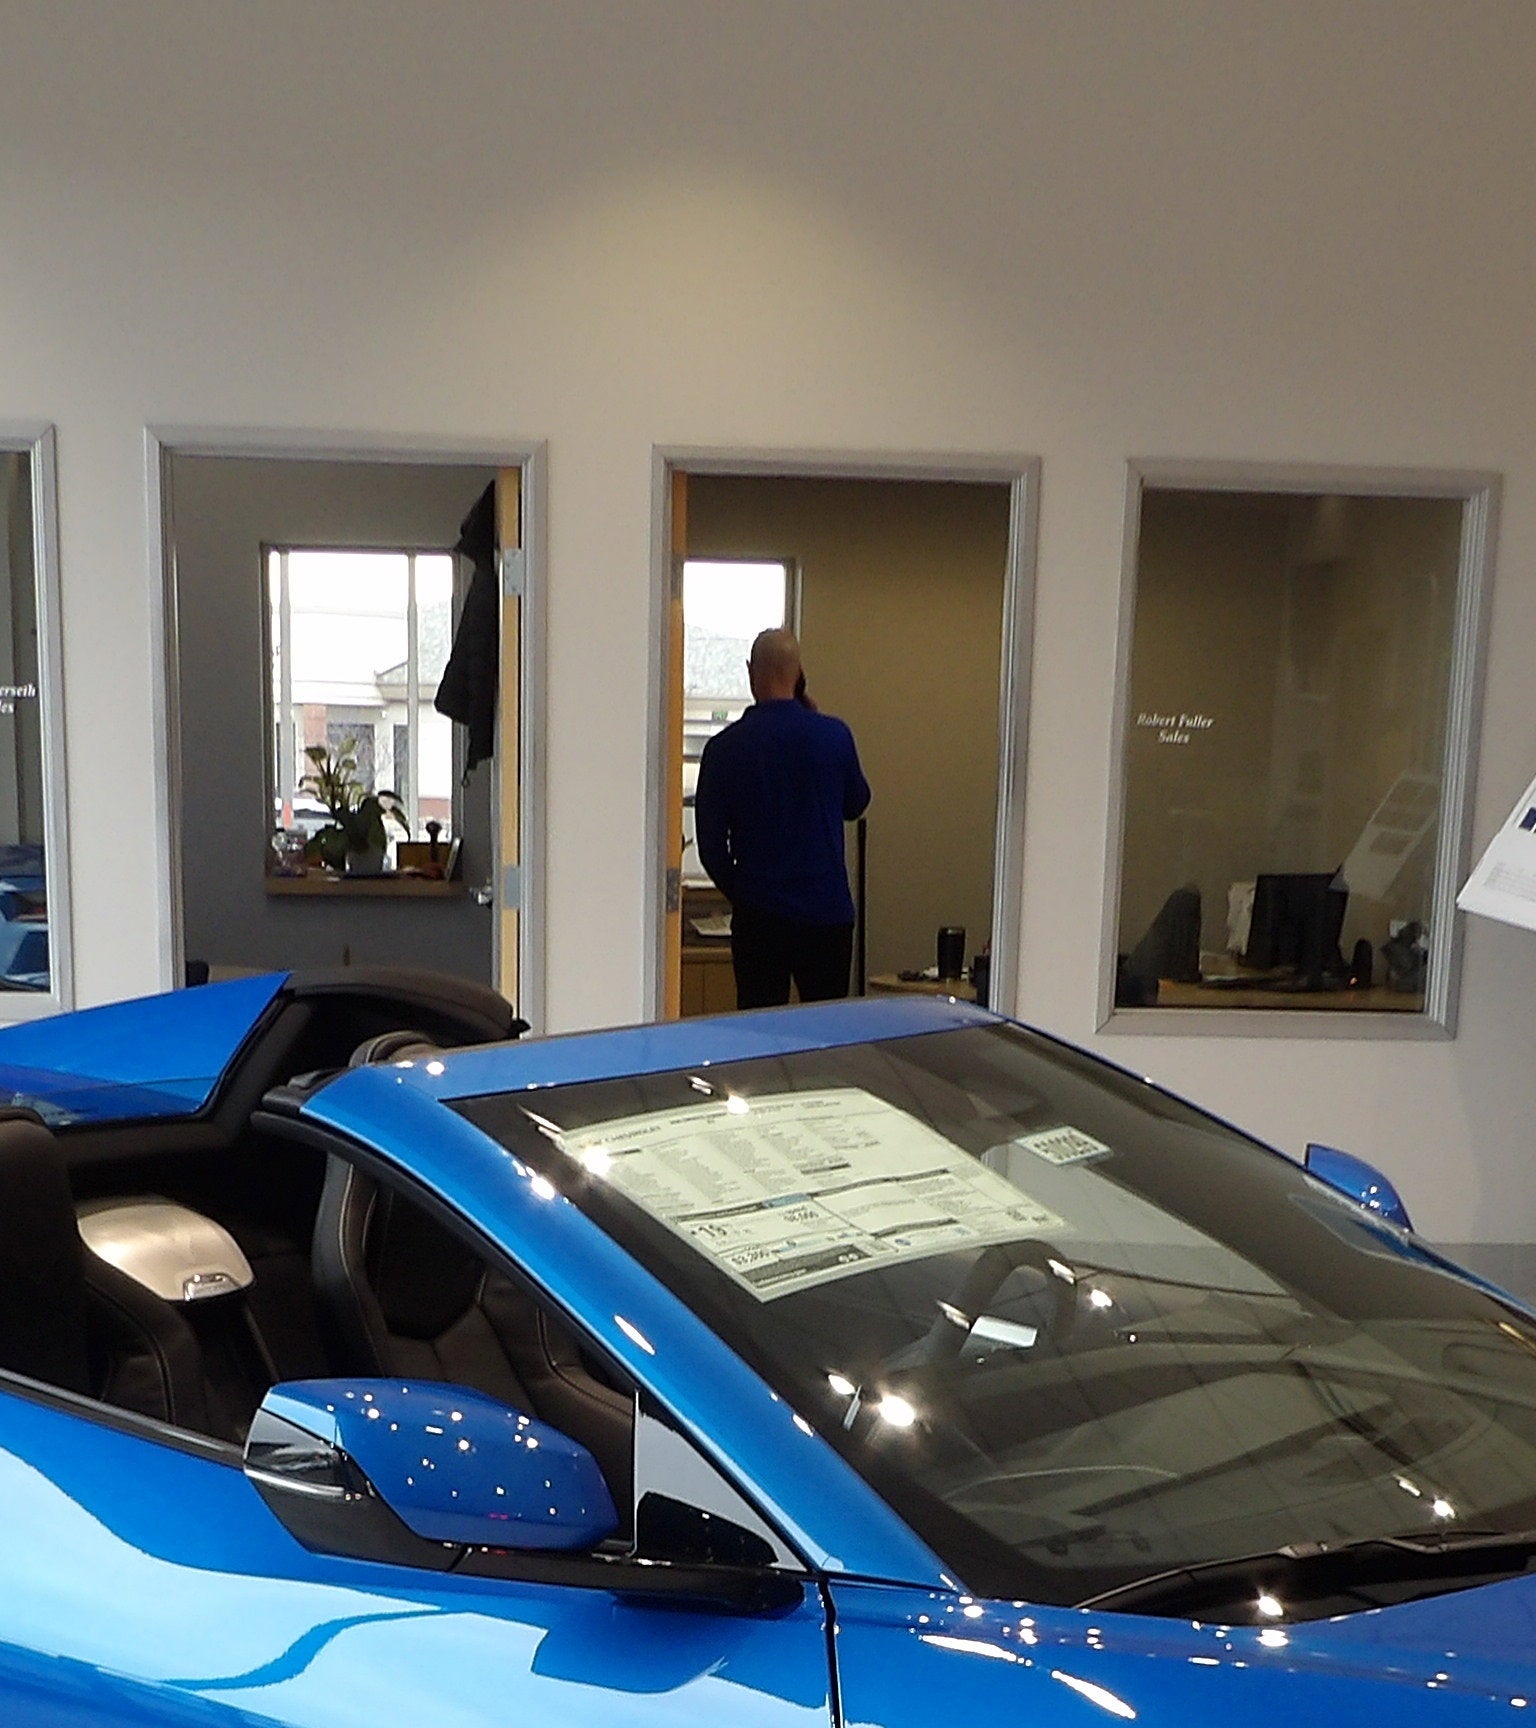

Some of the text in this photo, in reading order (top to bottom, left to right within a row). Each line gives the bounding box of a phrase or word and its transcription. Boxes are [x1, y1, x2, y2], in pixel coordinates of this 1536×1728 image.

[1136, 712, 1215, 729] Robert Fuller
[1158, 729, 1190, 744] Sales
